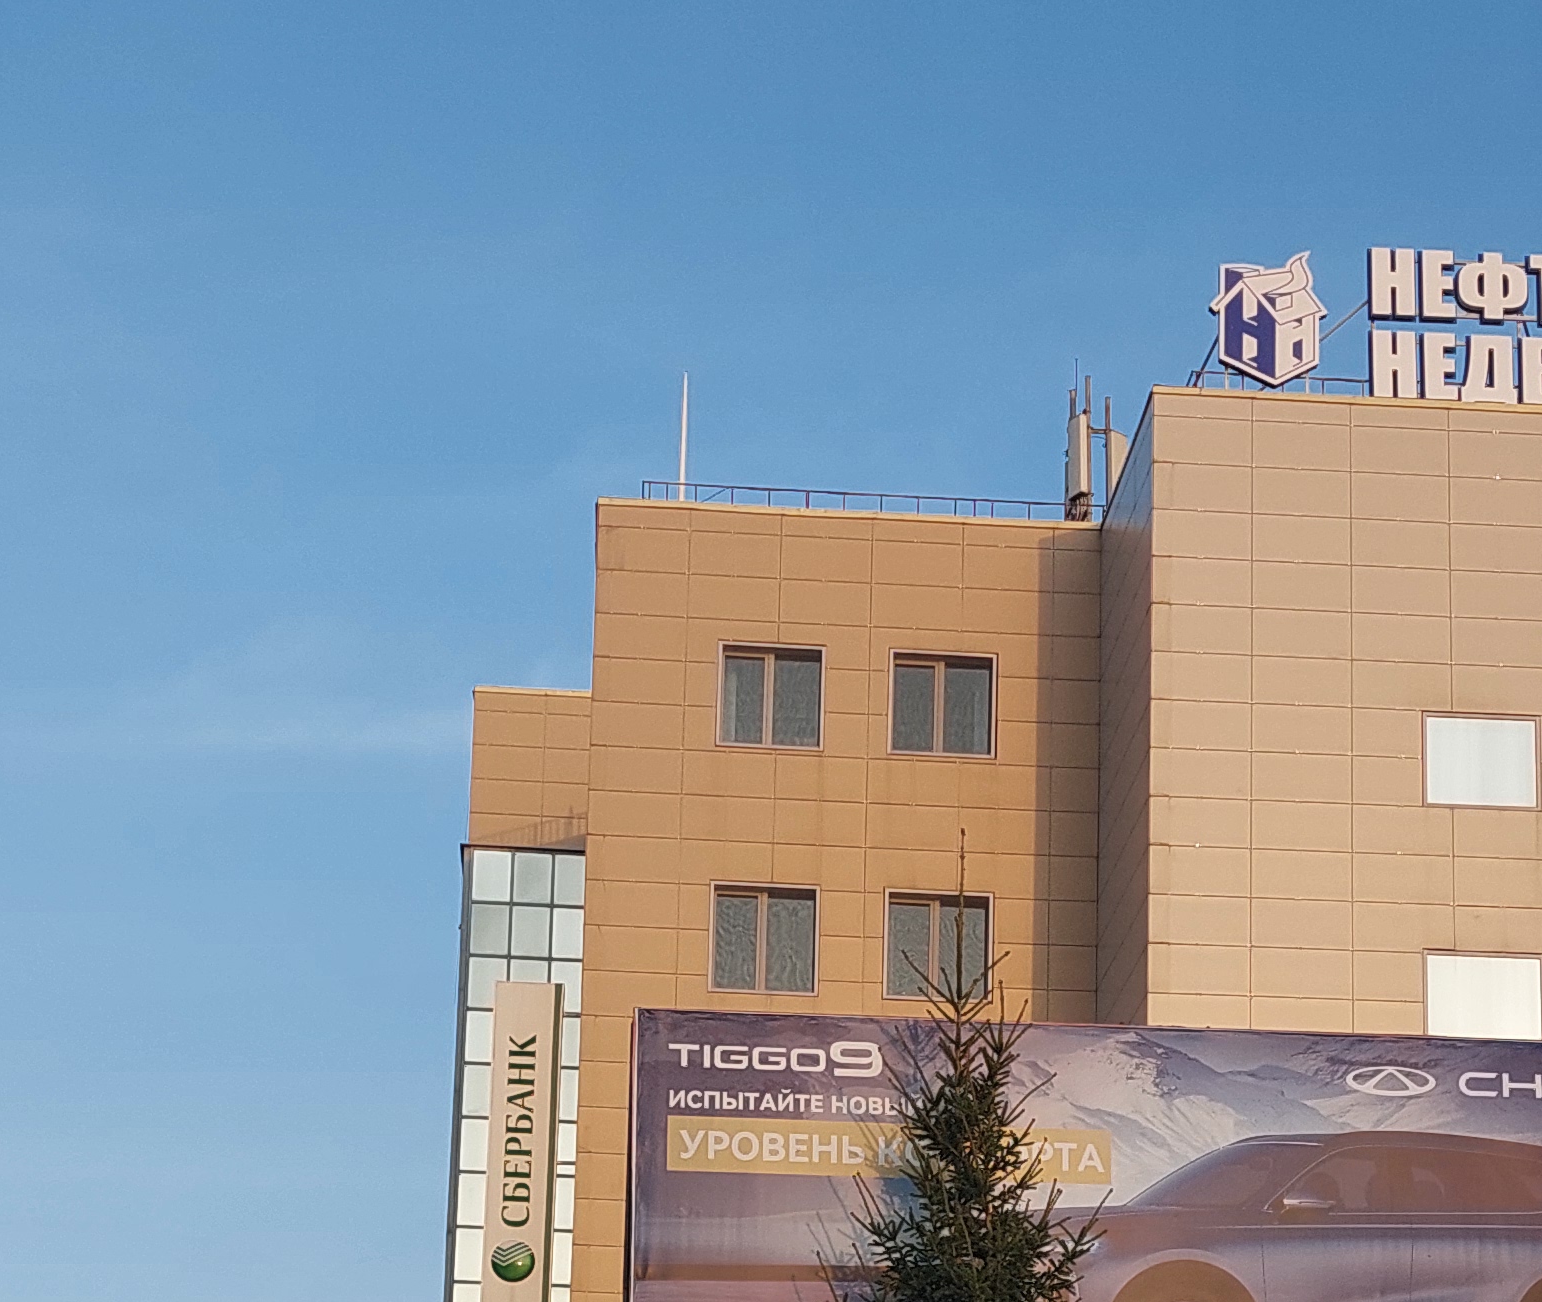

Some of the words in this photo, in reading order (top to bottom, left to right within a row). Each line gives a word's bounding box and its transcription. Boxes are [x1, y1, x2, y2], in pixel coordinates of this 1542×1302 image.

[668, 1088, 824, 1113] ИСПЫТАЙТЕ
[501, 1034, 537, 1227] СБЕРБАНК
[678, 1128, 865, 1165] УРОВЕНЬ
